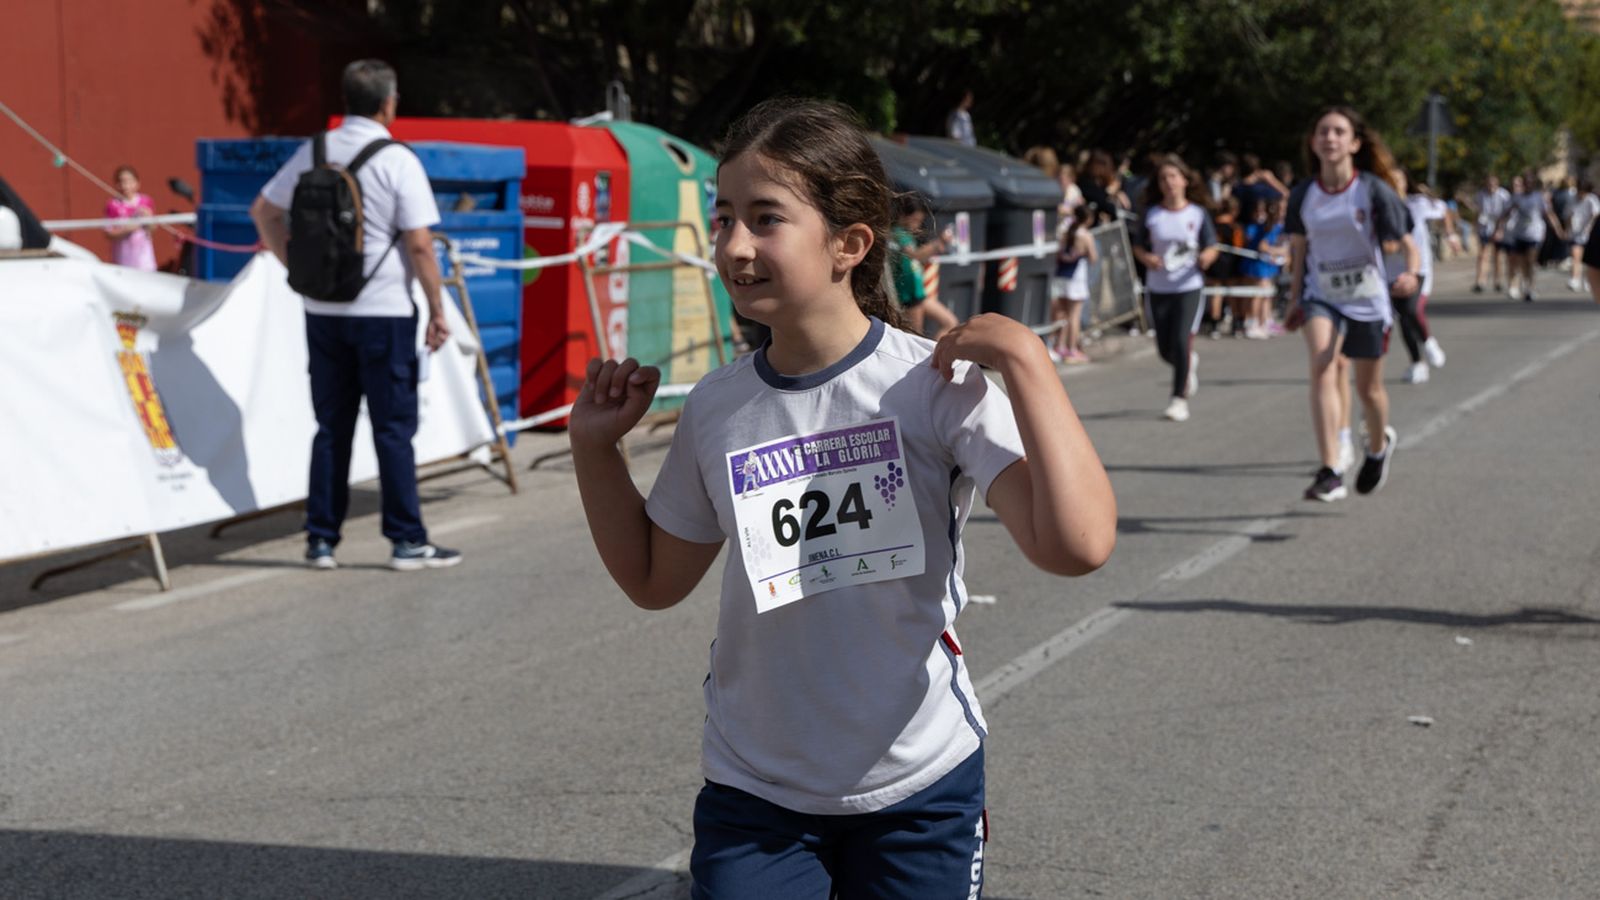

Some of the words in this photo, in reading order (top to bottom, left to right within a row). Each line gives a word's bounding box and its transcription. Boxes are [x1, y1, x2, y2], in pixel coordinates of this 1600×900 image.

[803, 436, 848, 455] CARRERA
[849, 428, 891, 447] ESCOLAR
[815, 452, 831, 467] LA
[838, 443, 881, 463] GLORIA
[756, 447, 805, 482] XXXVI
[772, 482, 873, 547] 624
